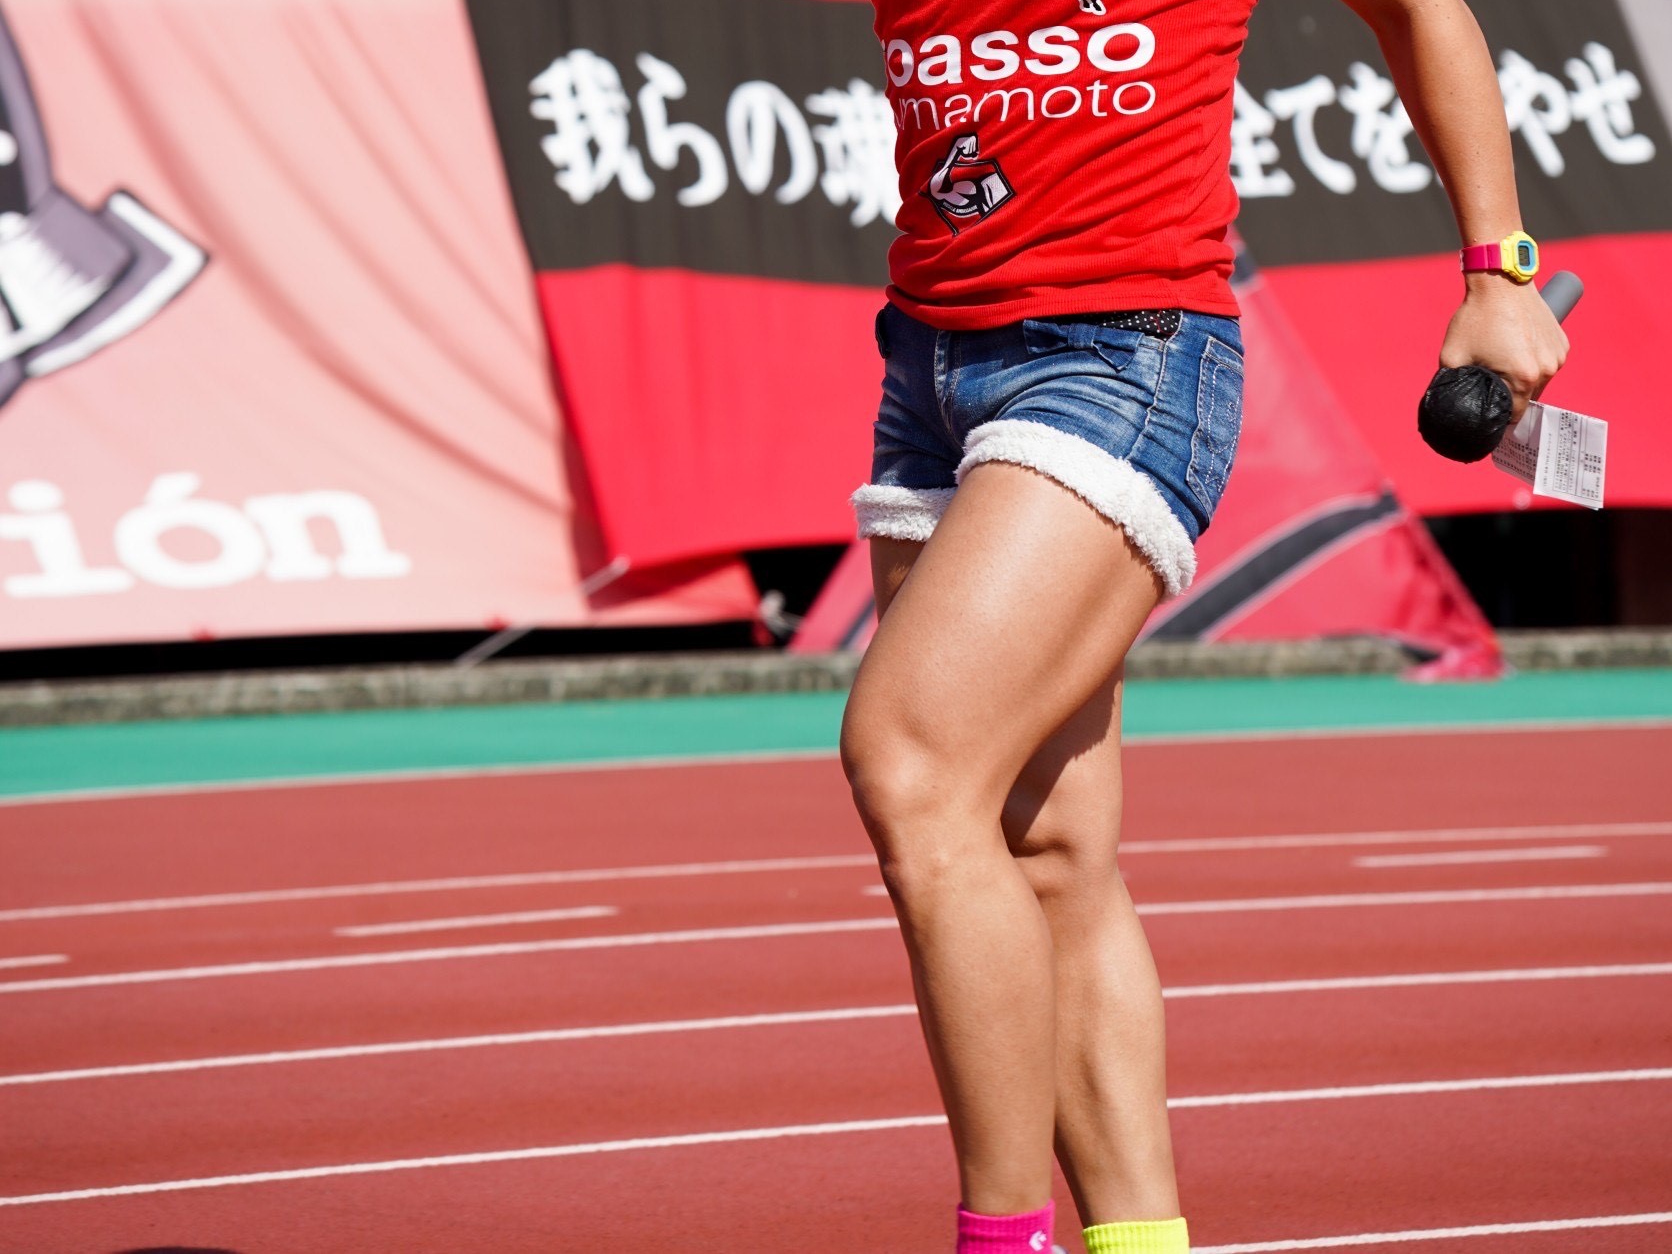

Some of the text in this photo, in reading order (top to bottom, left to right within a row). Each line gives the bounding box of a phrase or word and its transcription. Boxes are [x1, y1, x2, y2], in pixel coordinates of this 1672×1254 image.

[882, 22, 1156, 87] oasso
[1230, 41, 1656, 199] 全てをやせ
